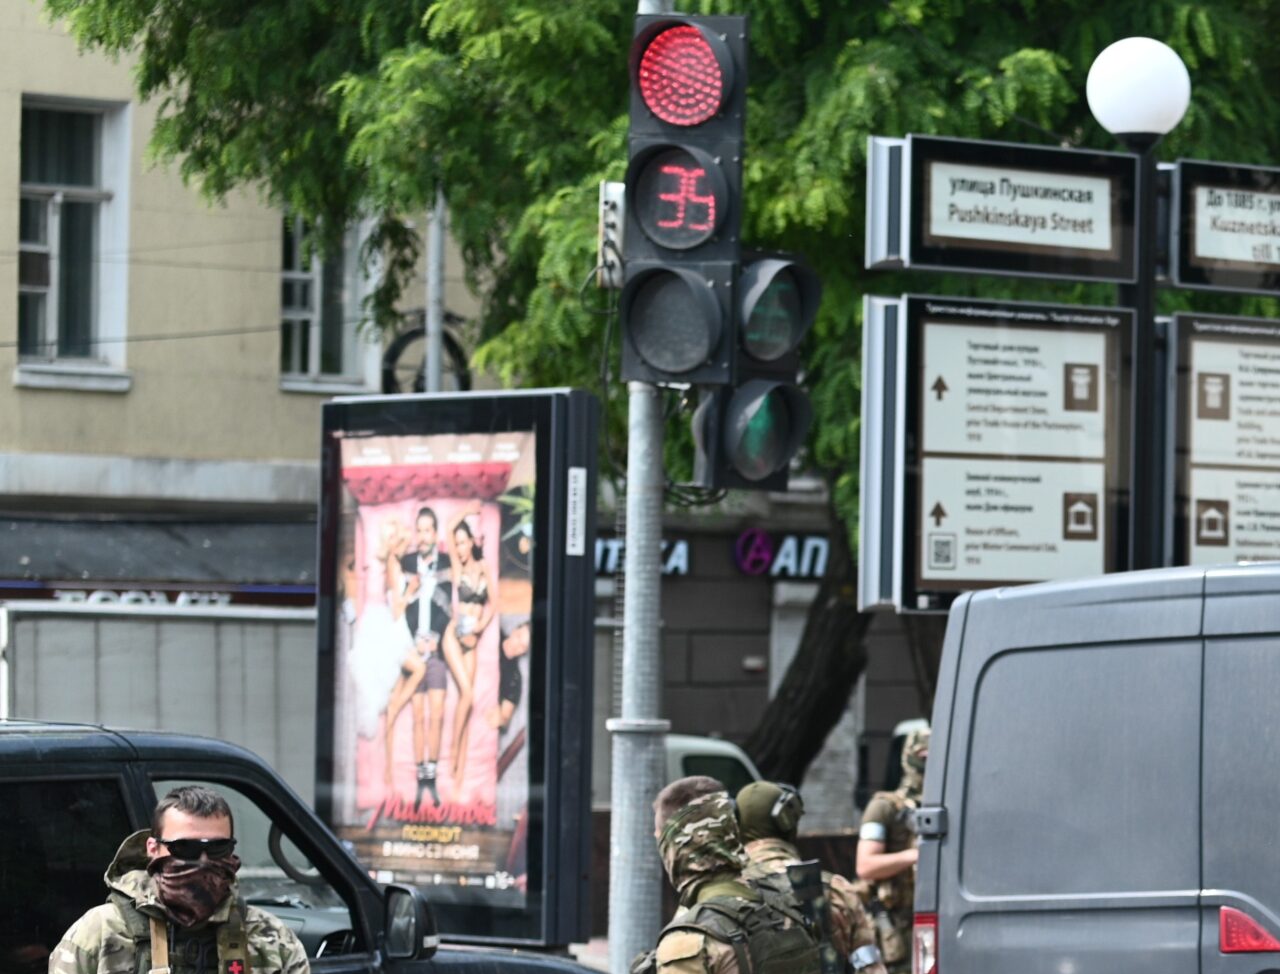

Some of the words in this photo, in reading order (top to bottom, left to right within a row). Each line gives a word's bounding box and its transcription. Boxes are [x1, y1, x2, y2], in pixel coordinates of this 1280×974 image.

[657, 165, 716, 231] 35
[949, 176, 995, 199] улица
[998, 177, 1094, 203] Пушкинская
[1206, 190, 1222, 207] До
[1226, 191, 1256, 209] 1885
[948, 204, 1047, 232] Pushkinskaya
[1050, 213, 1094, 233] Street
[1252, 244, 1273, 261] till
